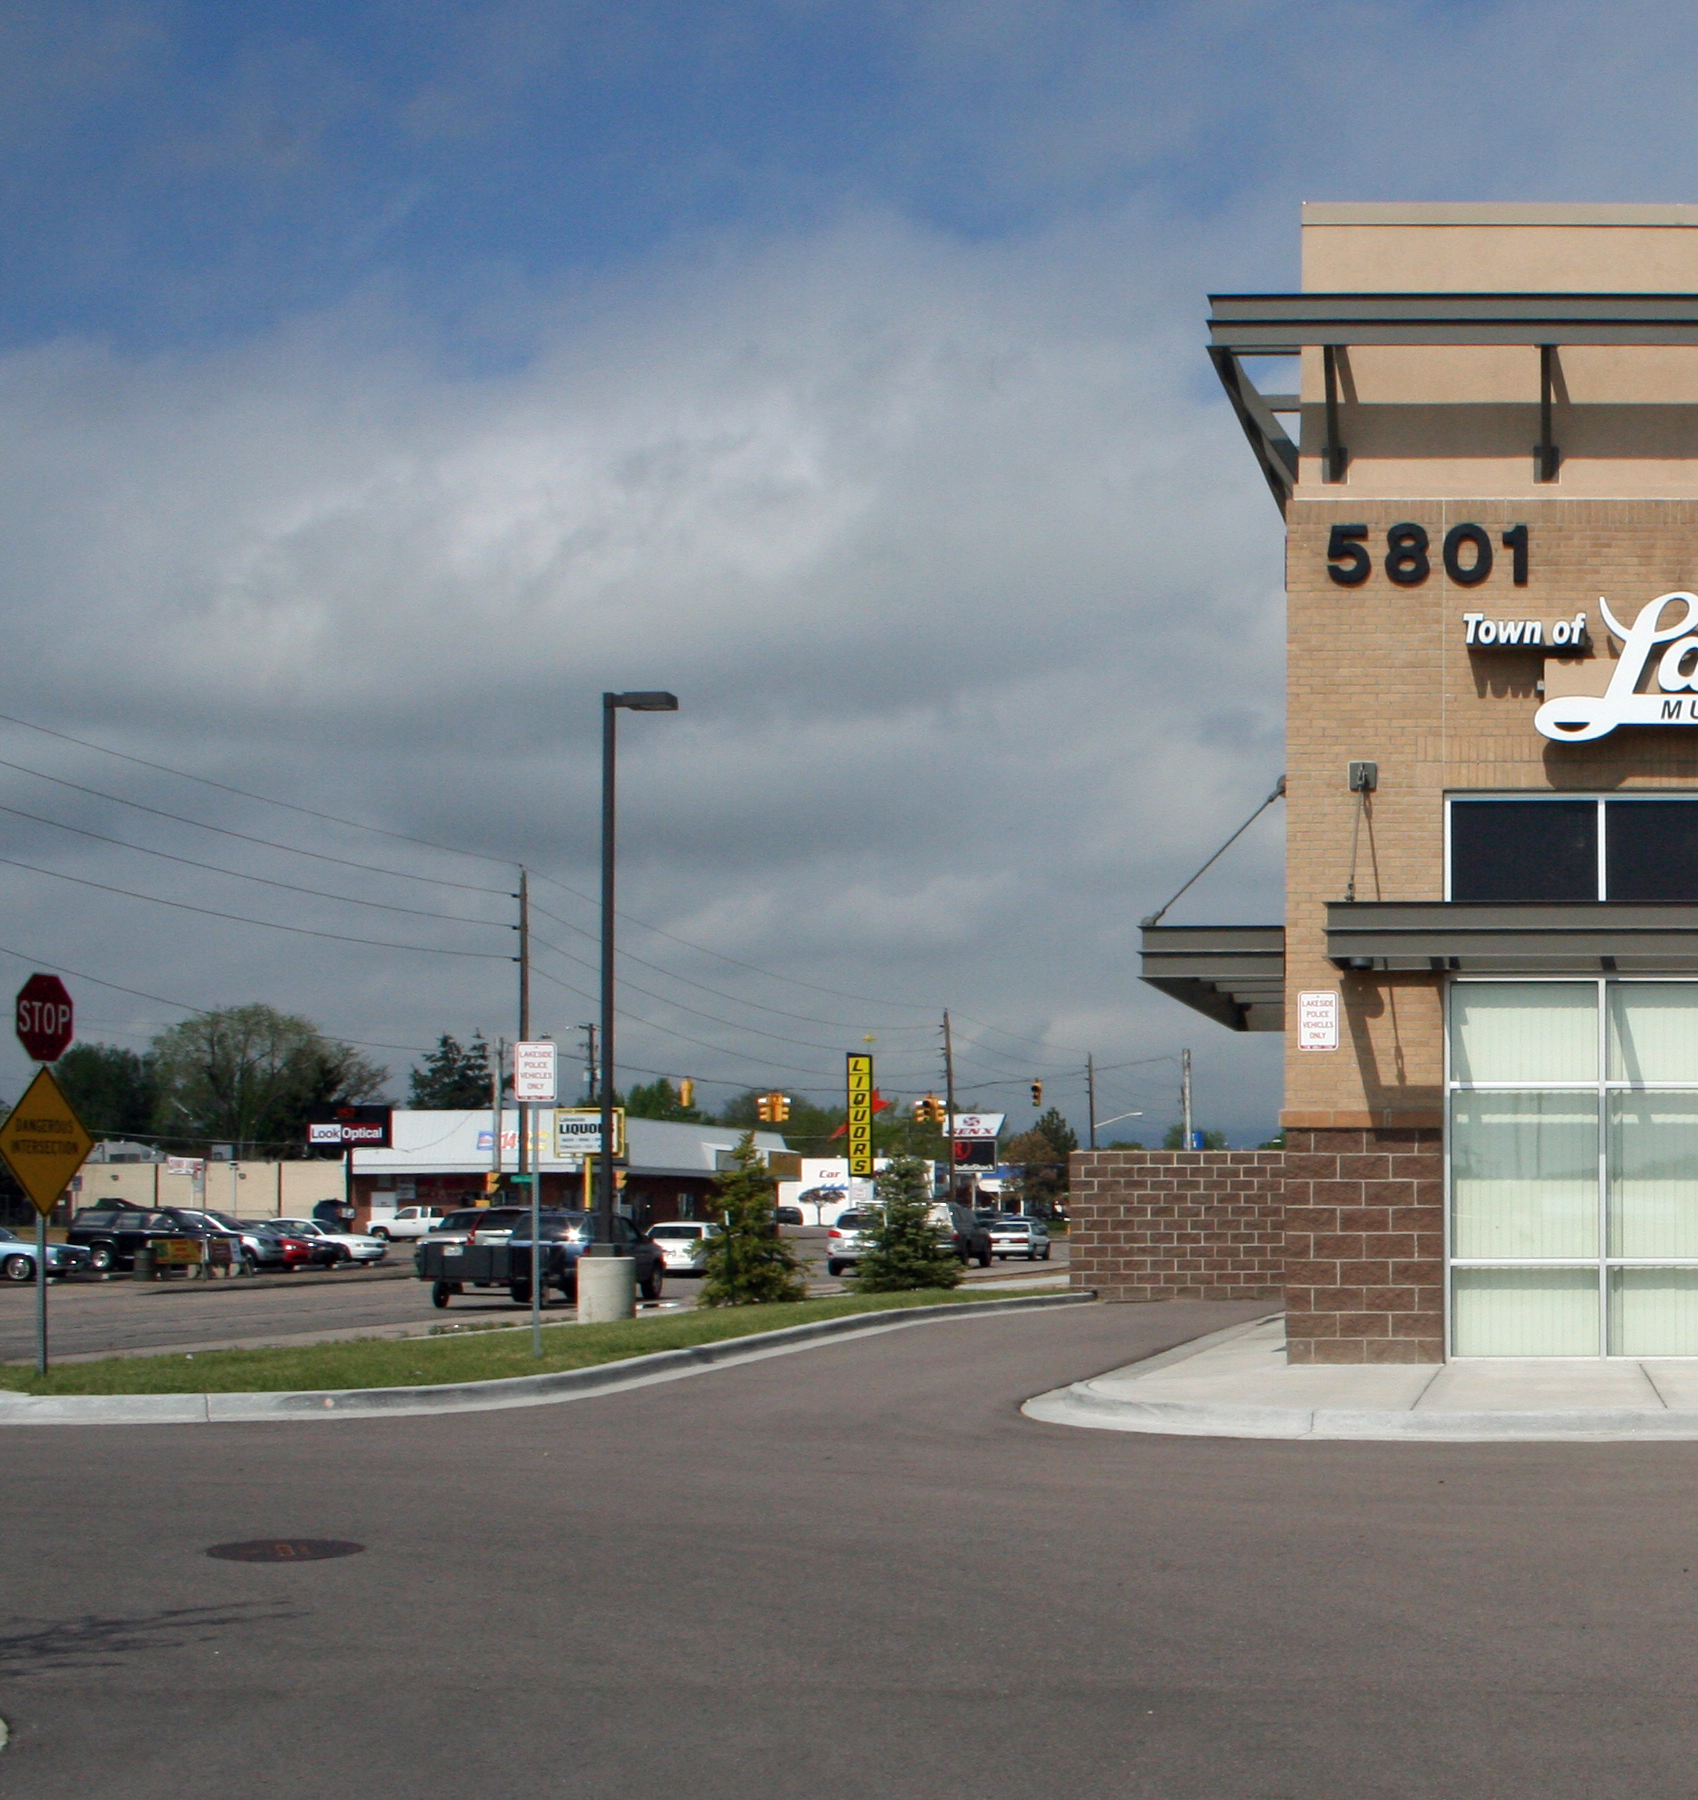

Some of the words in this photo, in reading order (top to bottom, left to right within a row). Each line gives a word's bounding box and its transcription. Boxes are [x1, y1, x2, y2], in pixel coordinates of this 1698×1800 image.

[1326, 523, 1529, 587] 5801
[1463, 612, 1543, 645] Town
[1552, 612, 1587, 645] of
[18, 1000, 71, 1035] STOP
[520, 1051, 554, 1059] LAKESIDE
[524, 1061, 549, 1069] POLICE
[851, 1059, 868, 1173] LIQUORS
[15, 1117, 74, 1134] DANGEROUS
[311, 1127, 341, 1139] Look
[342, 1126, 383, 1141] Optical
[559, 1123, 615, 1136] LIQUO
[10, 1138, 80, 1154] INTERSECTION
[818, 1169, 841, 1179] Car
